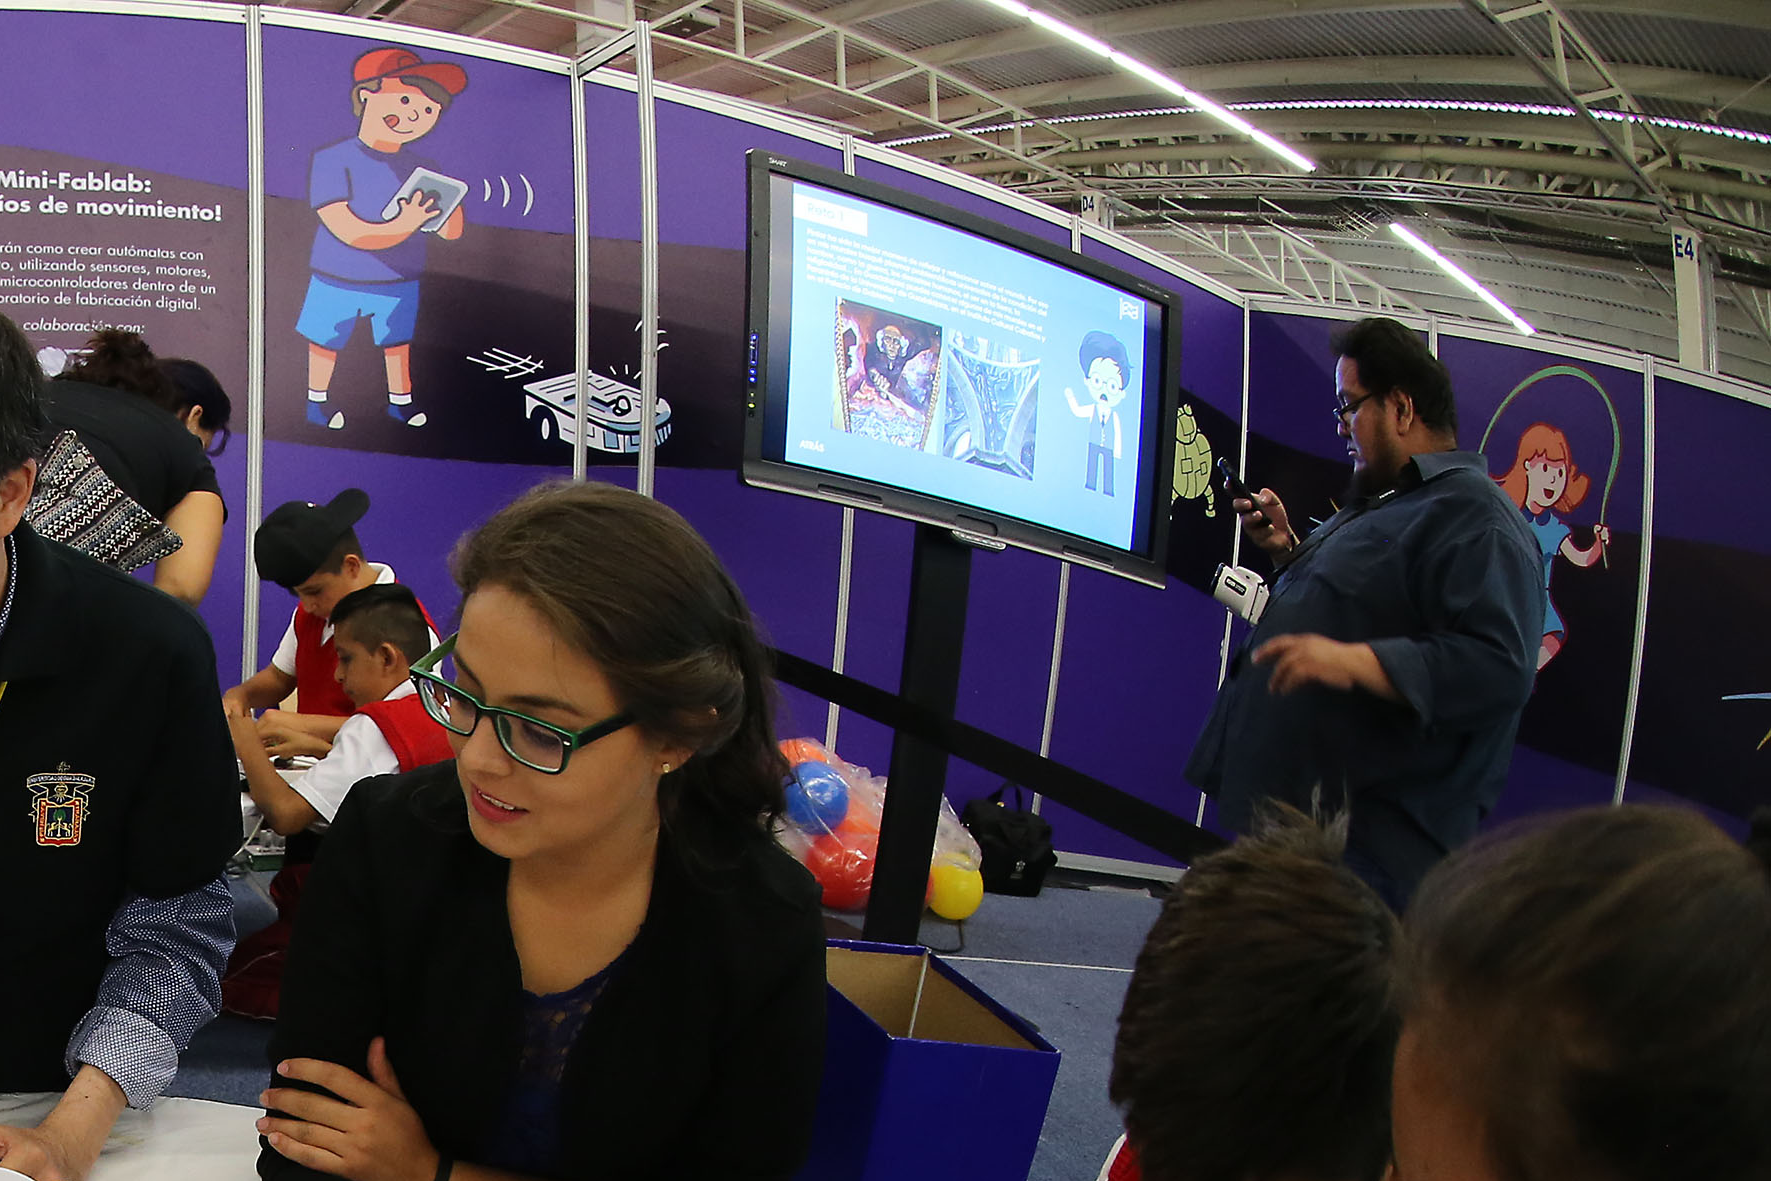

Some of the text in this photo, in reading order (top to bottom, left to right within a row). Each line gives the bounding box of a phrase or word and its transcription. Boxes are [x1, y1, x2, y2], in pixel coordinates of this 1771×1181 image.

[39, 195, 69, 213] de
[76, 198, 222, 222] movimiento!
[1082, 195, 1095, 212] D4
[26, 245, 64, 255] como
[68, 246, 103, 256] crear
[107, 245, 176, 259] autómatas
[180, 251, 204, 260] con
[1674, 234, 1694, 261] E4
[19, 257, 86, 271] utilizando
[90, 262, 151, 276] sensores,
[155, 264, 211, 280] motores,
[0, 275, 128, 290] microcontroladores
[132, 278, 175, 292] dentro
[179, 280, 196, 293] de
[200, 285, 216, 295] un
[54, 292, 72, 305] de
[75, 292, 151, 308] fabricación
[155, 296, 202, 313] digital.
